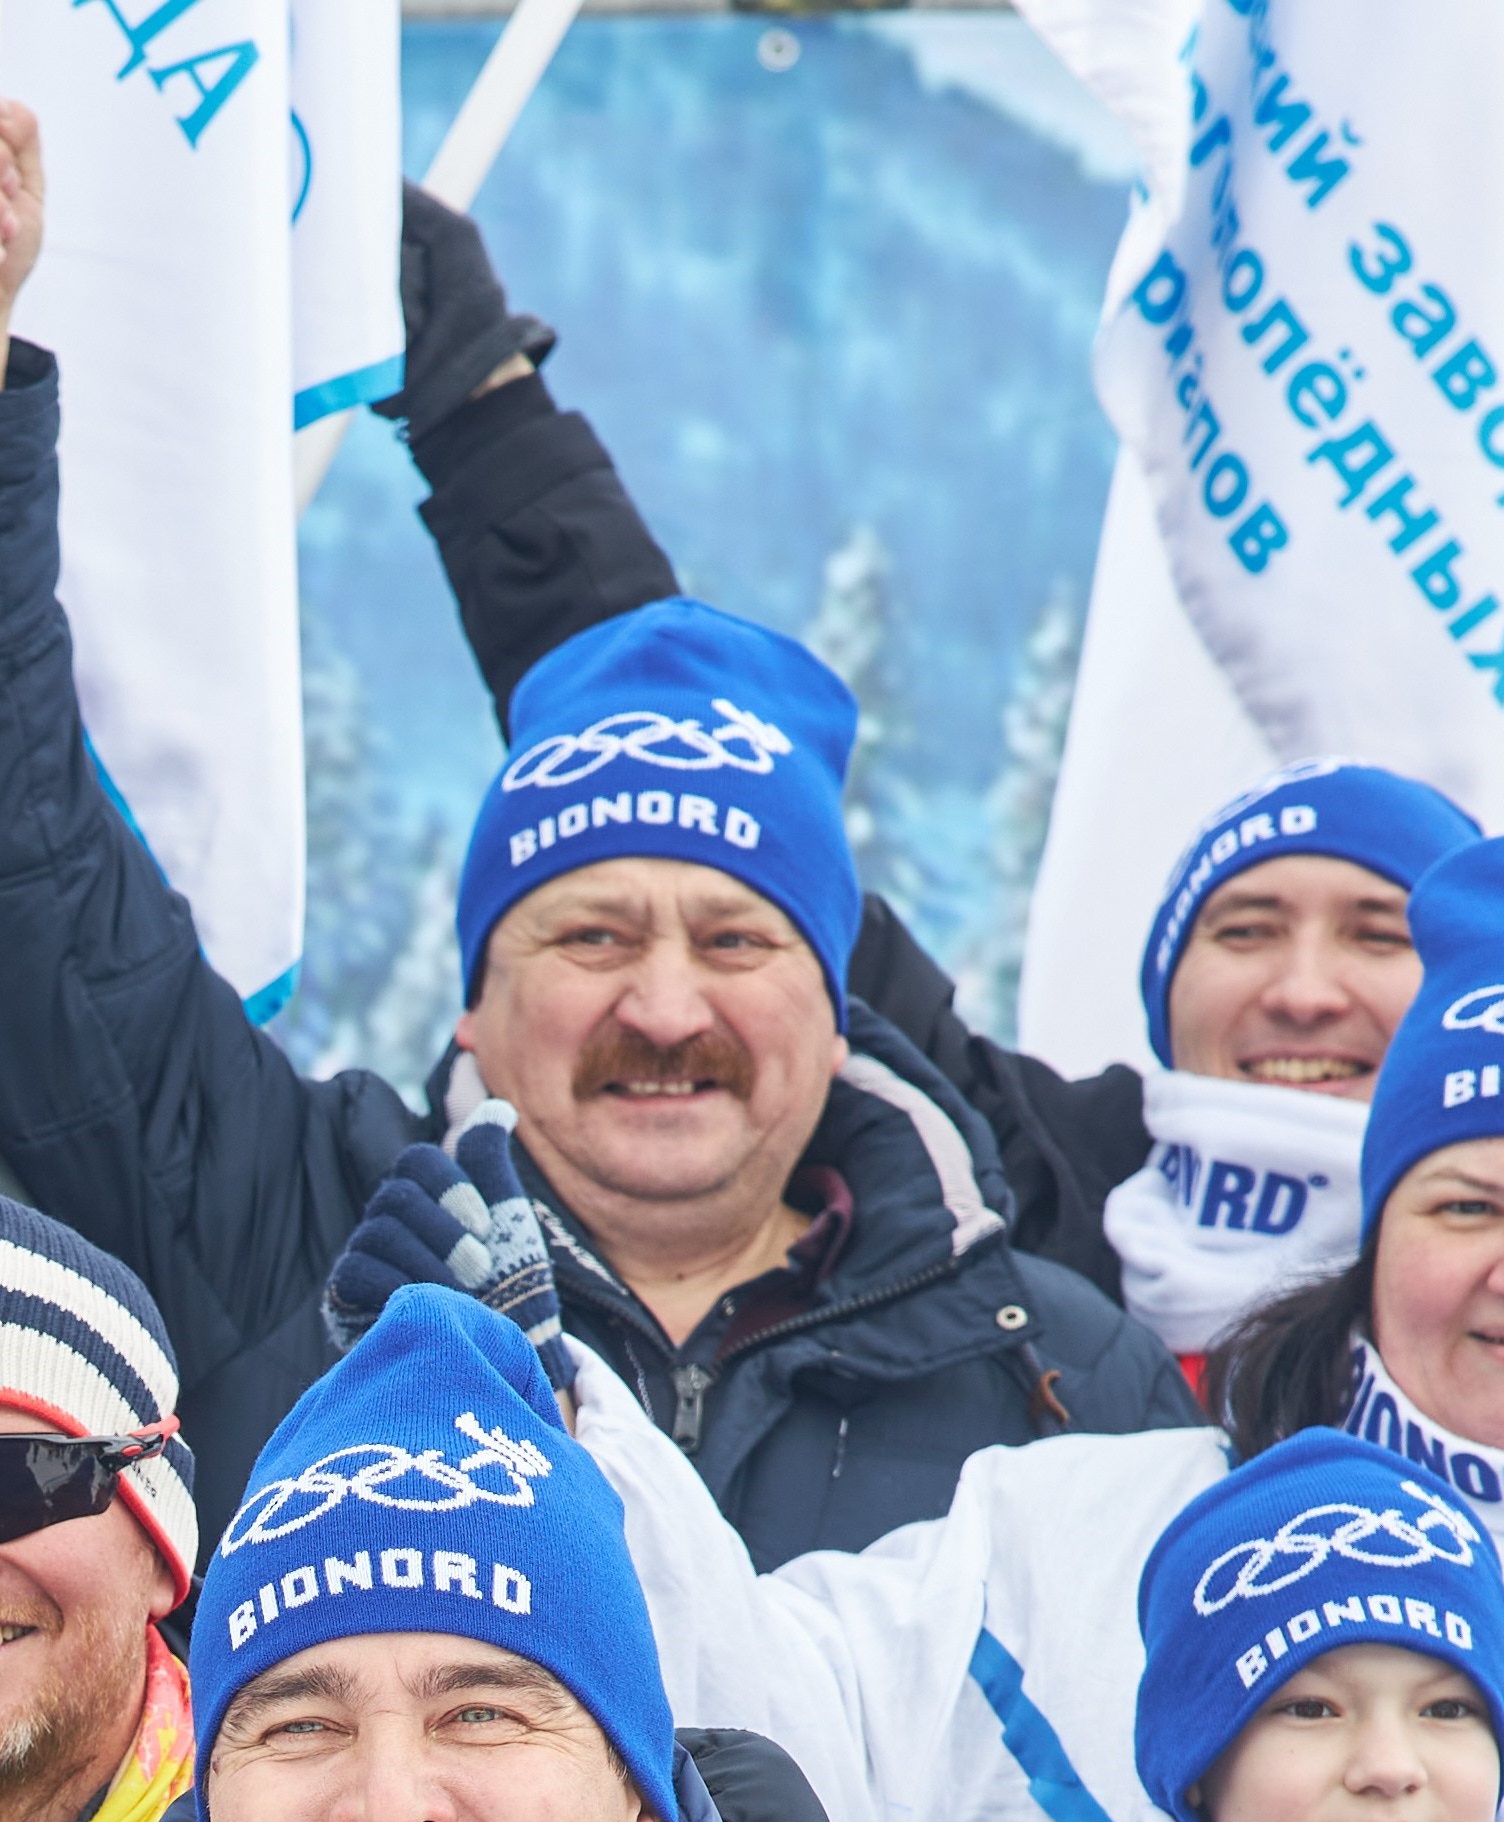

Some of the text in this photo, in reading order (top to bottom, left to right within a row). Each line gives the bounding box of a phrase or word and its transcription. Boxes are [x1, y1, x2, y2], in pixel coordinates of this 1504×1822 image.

[509, 789, 762, 866] BIONORD
[227, 1547, 533, 1652] BIONORD
[1235, 1594, 1474, 1690] BIONORD
